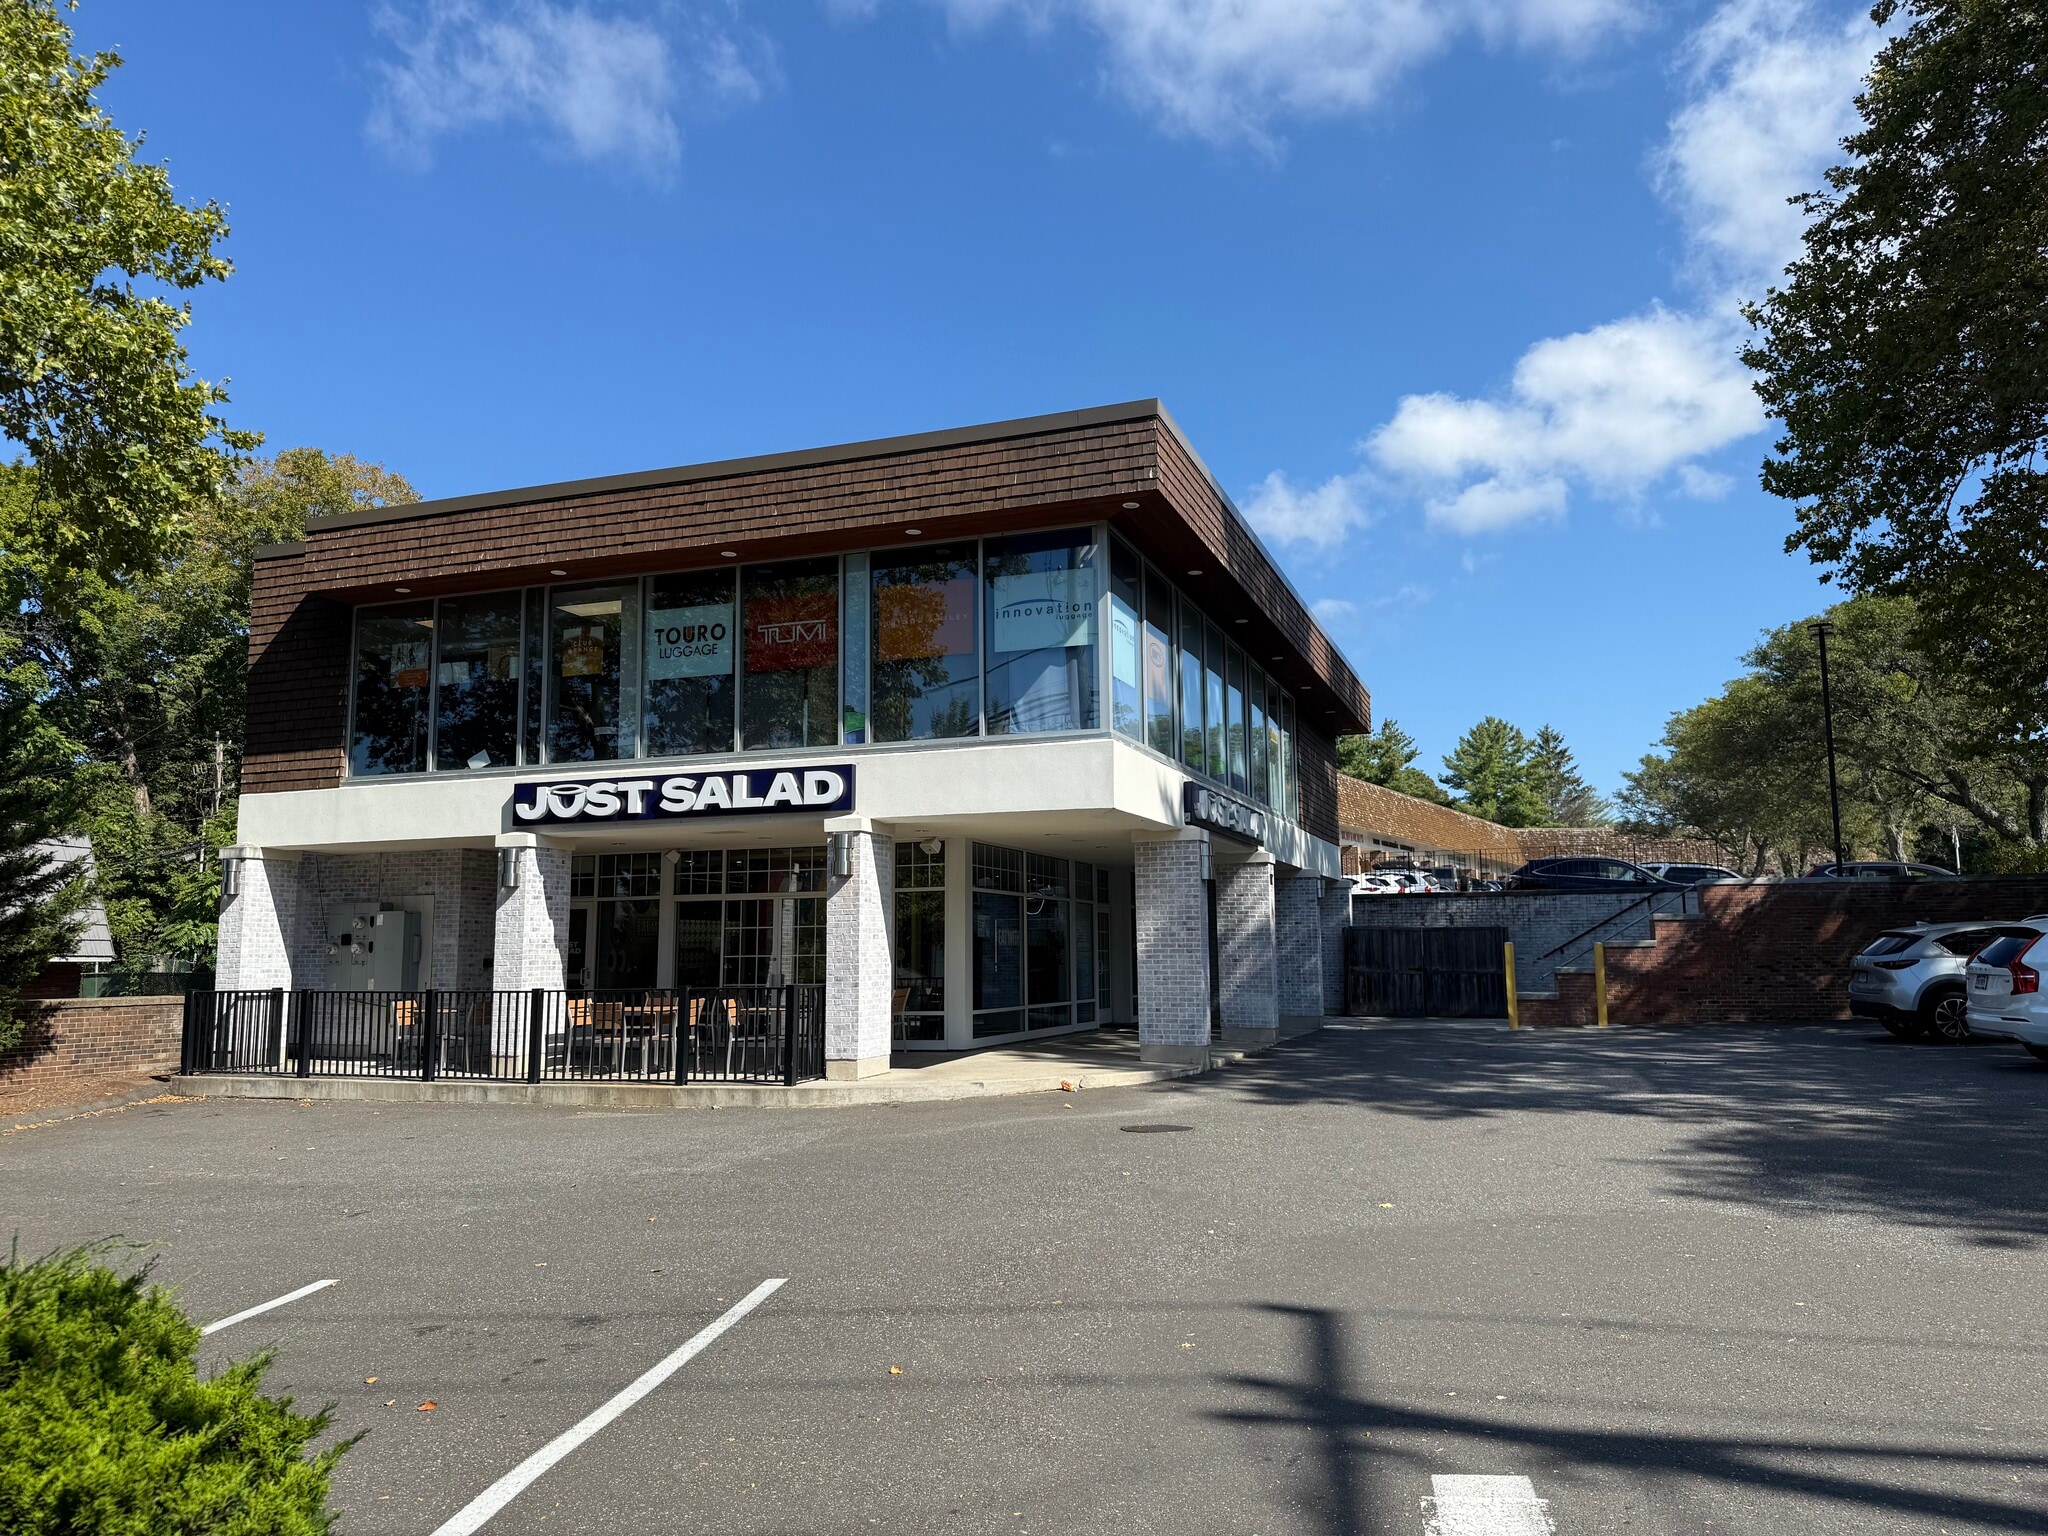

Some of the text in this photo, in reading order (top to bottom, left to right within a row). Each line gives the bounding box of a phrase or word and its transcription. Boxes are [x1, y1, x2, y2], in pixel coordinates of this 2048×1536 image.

[995, 600, 1093, 620] innovation
[1055, 611, 1093, 622] luggage
[654, 622, 727, 646] TOURO
[758, 619, 827, 645] TUMI
[659, 643, 719, 659] LUGGAGE
[515, 770, 845, 820] JUST SALAD
